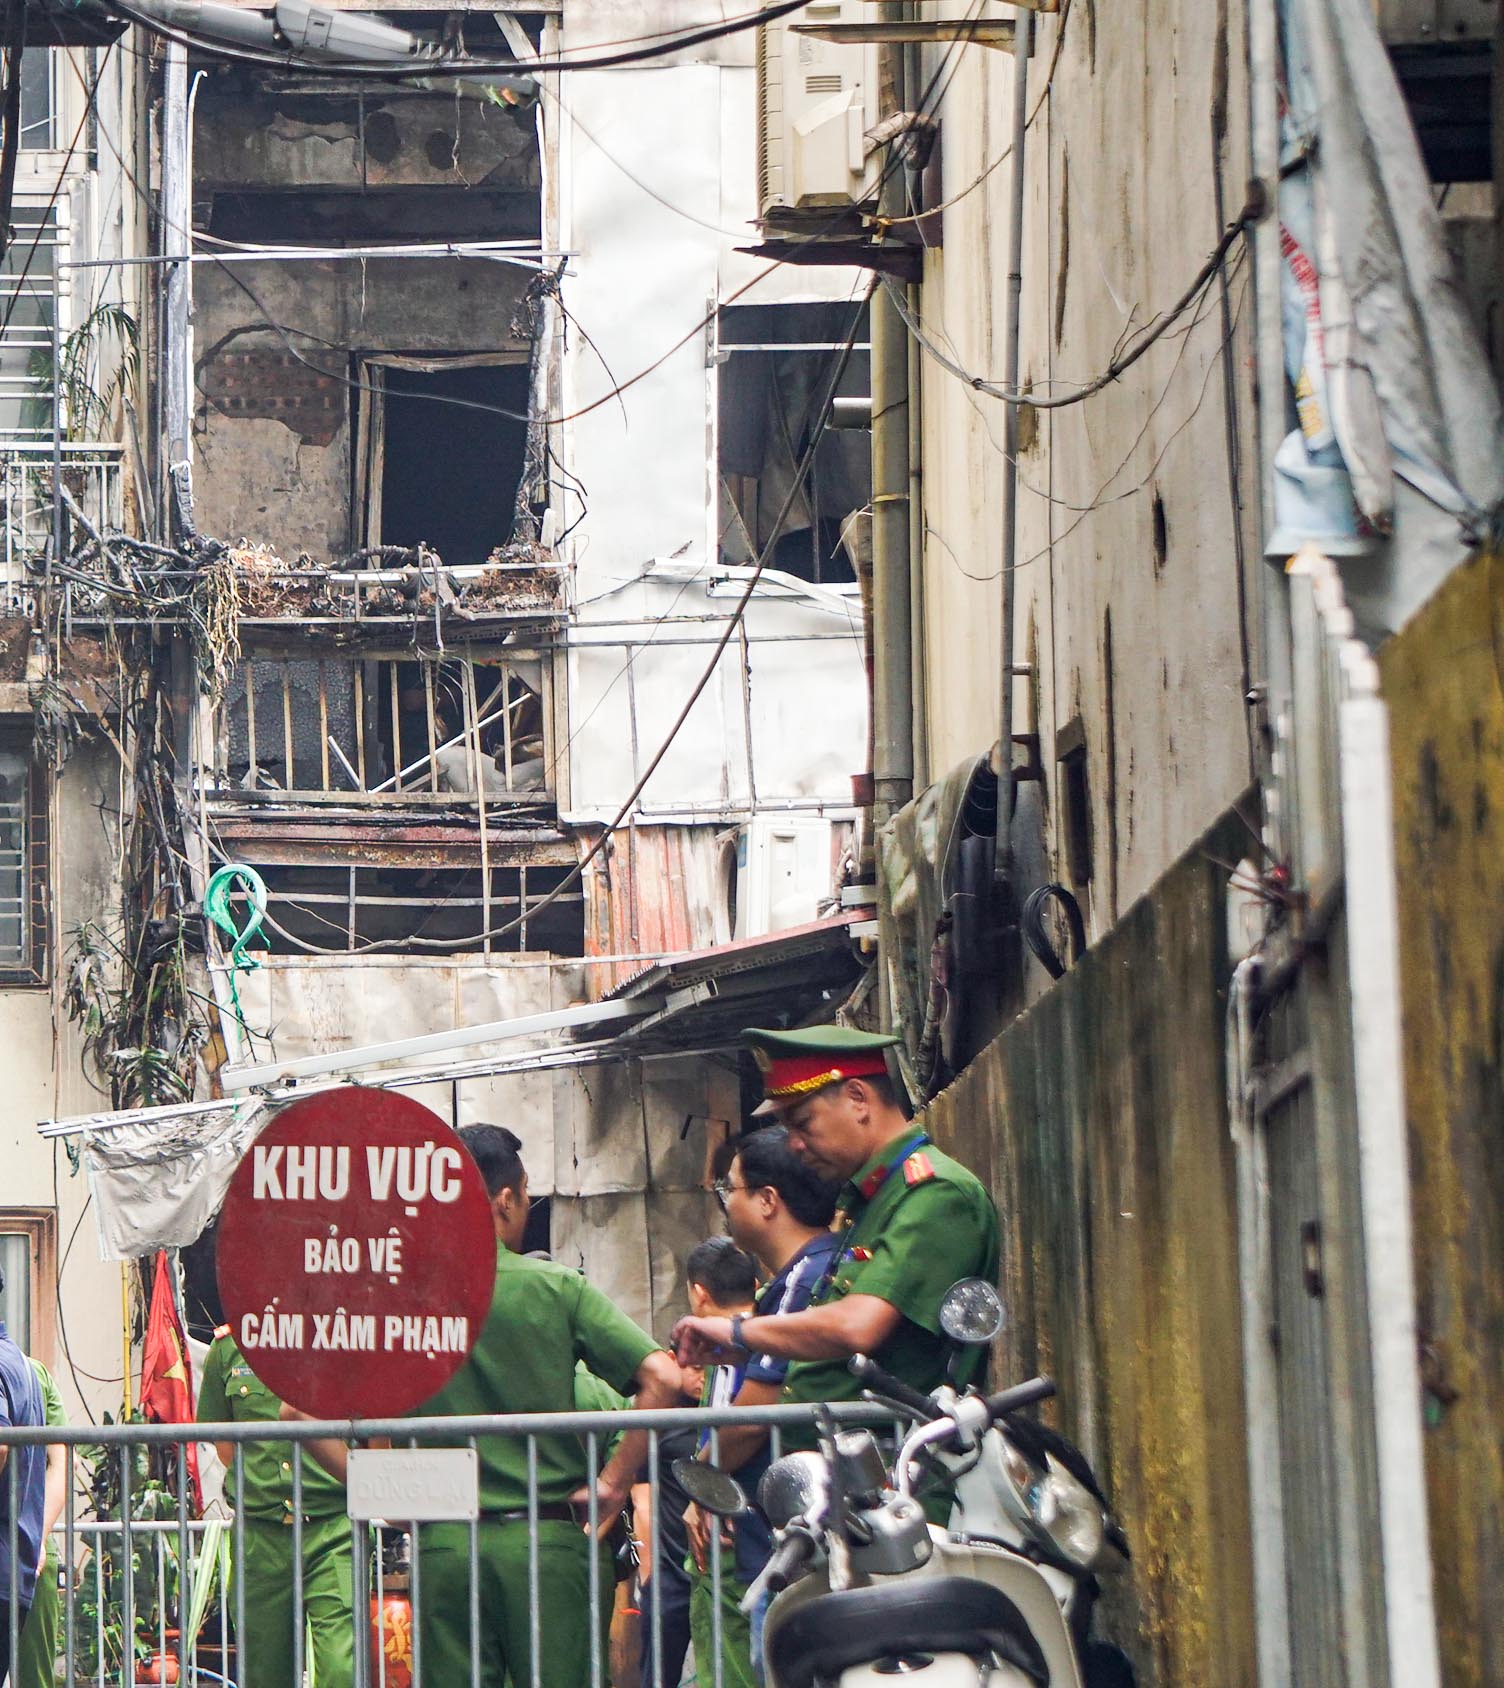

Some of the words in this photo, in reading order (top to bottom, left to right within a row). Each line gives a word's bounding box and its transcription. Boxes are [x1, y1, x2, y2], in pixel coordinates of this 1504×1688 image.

[253, 1146, 349, 1200] KHU
[365, 1141, 462, 1216] VỰC
[304, 1224, 359, 1273] BẢO
[368, 1227, 402, 1284] VỆ
[241, 1296, 302, 1349] CẤM
[312, 1307, 376, 1350] XÂM
[384, 1316, 468, 1359] PHẠM
